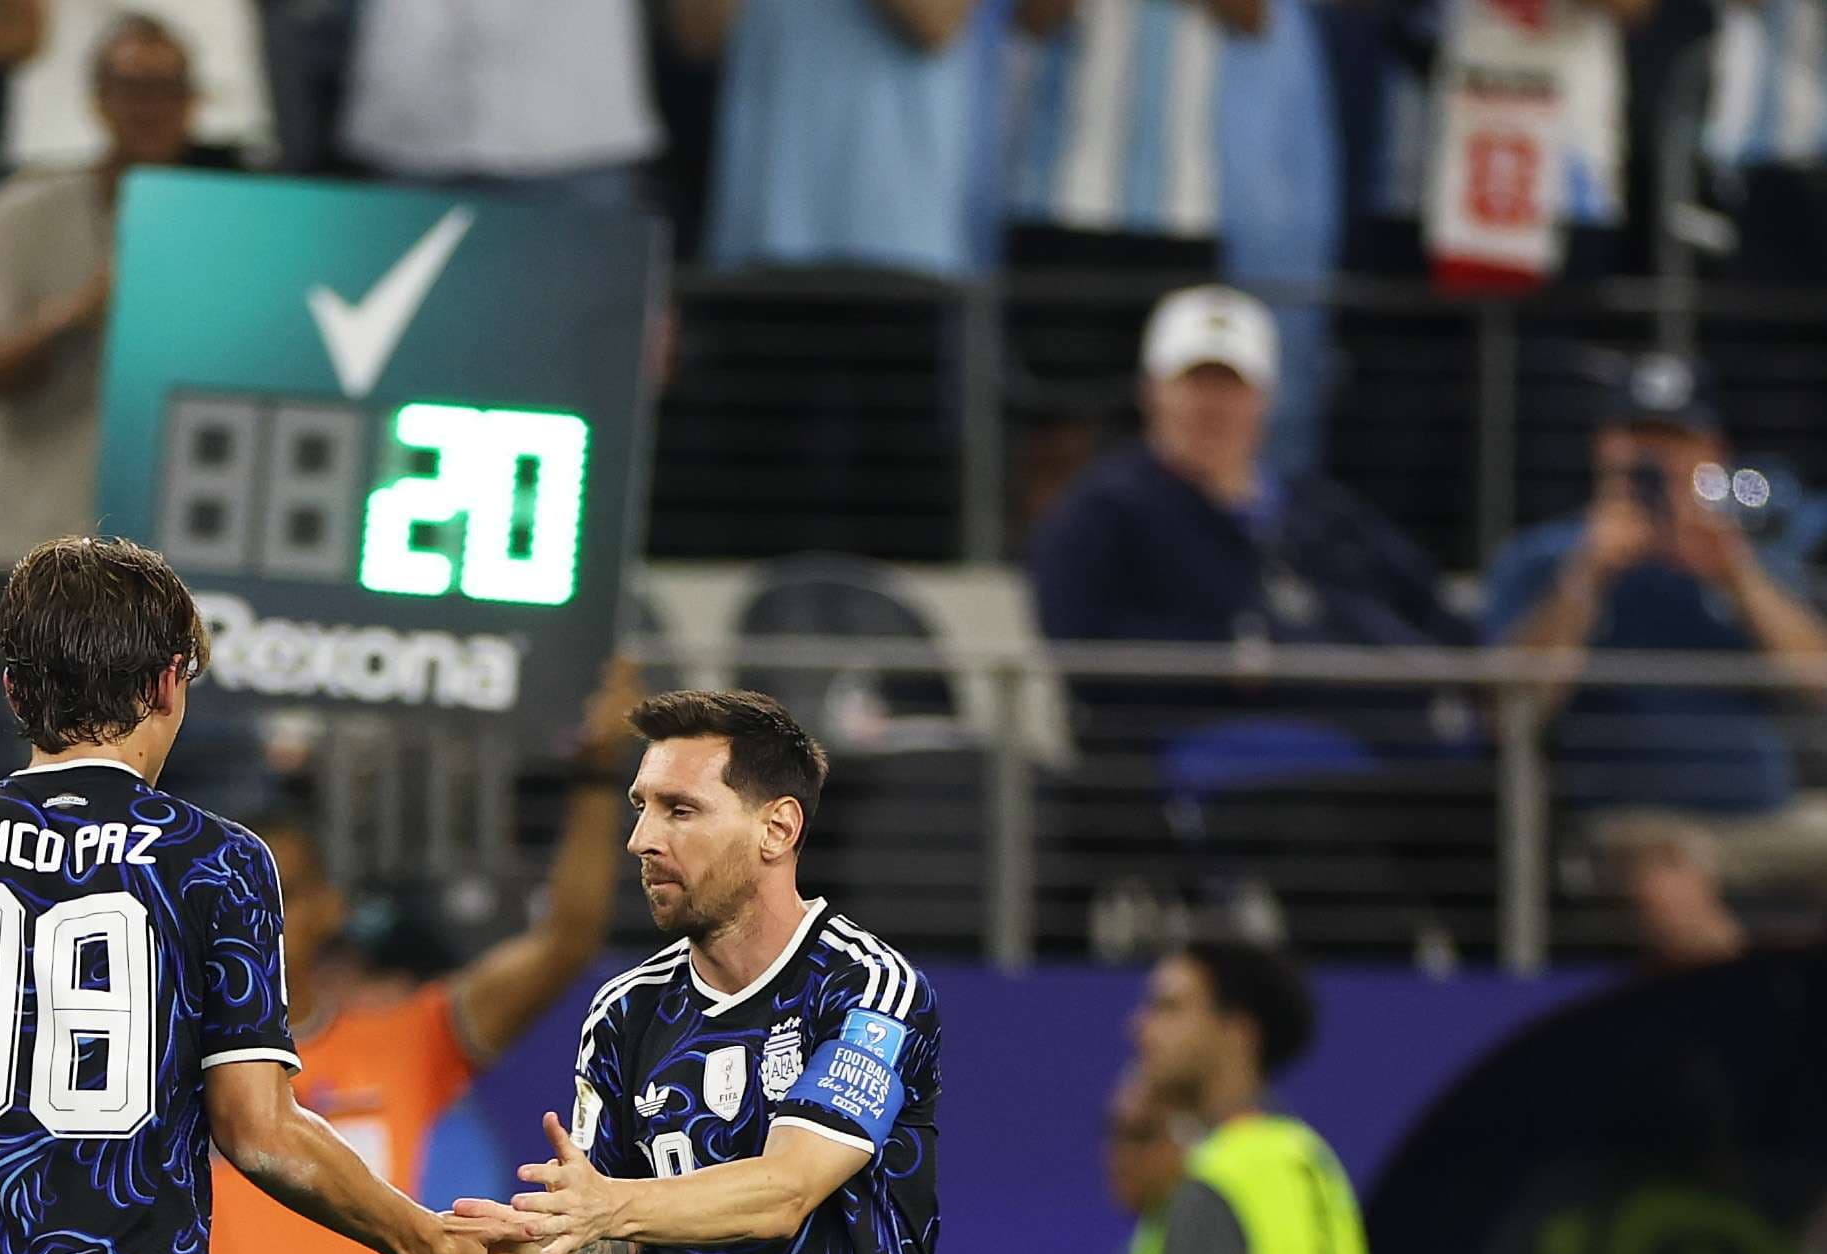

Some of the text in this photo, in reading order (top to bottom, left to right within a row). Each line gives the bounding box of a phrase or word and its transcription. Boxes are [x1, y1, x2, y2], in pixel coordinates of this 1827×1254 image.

[360, 402, 586, 606] 20
[190, 590, 526, 713] Rexona
[75, 822, 163, 874] PAZ
[827, 1060, 889, 1105] UNITES
[834, 1046, 892, 1089] FOOTBALL
[719, 1091, 738, 1103] FIFA
[817, 1076, 885, 1120] the World
